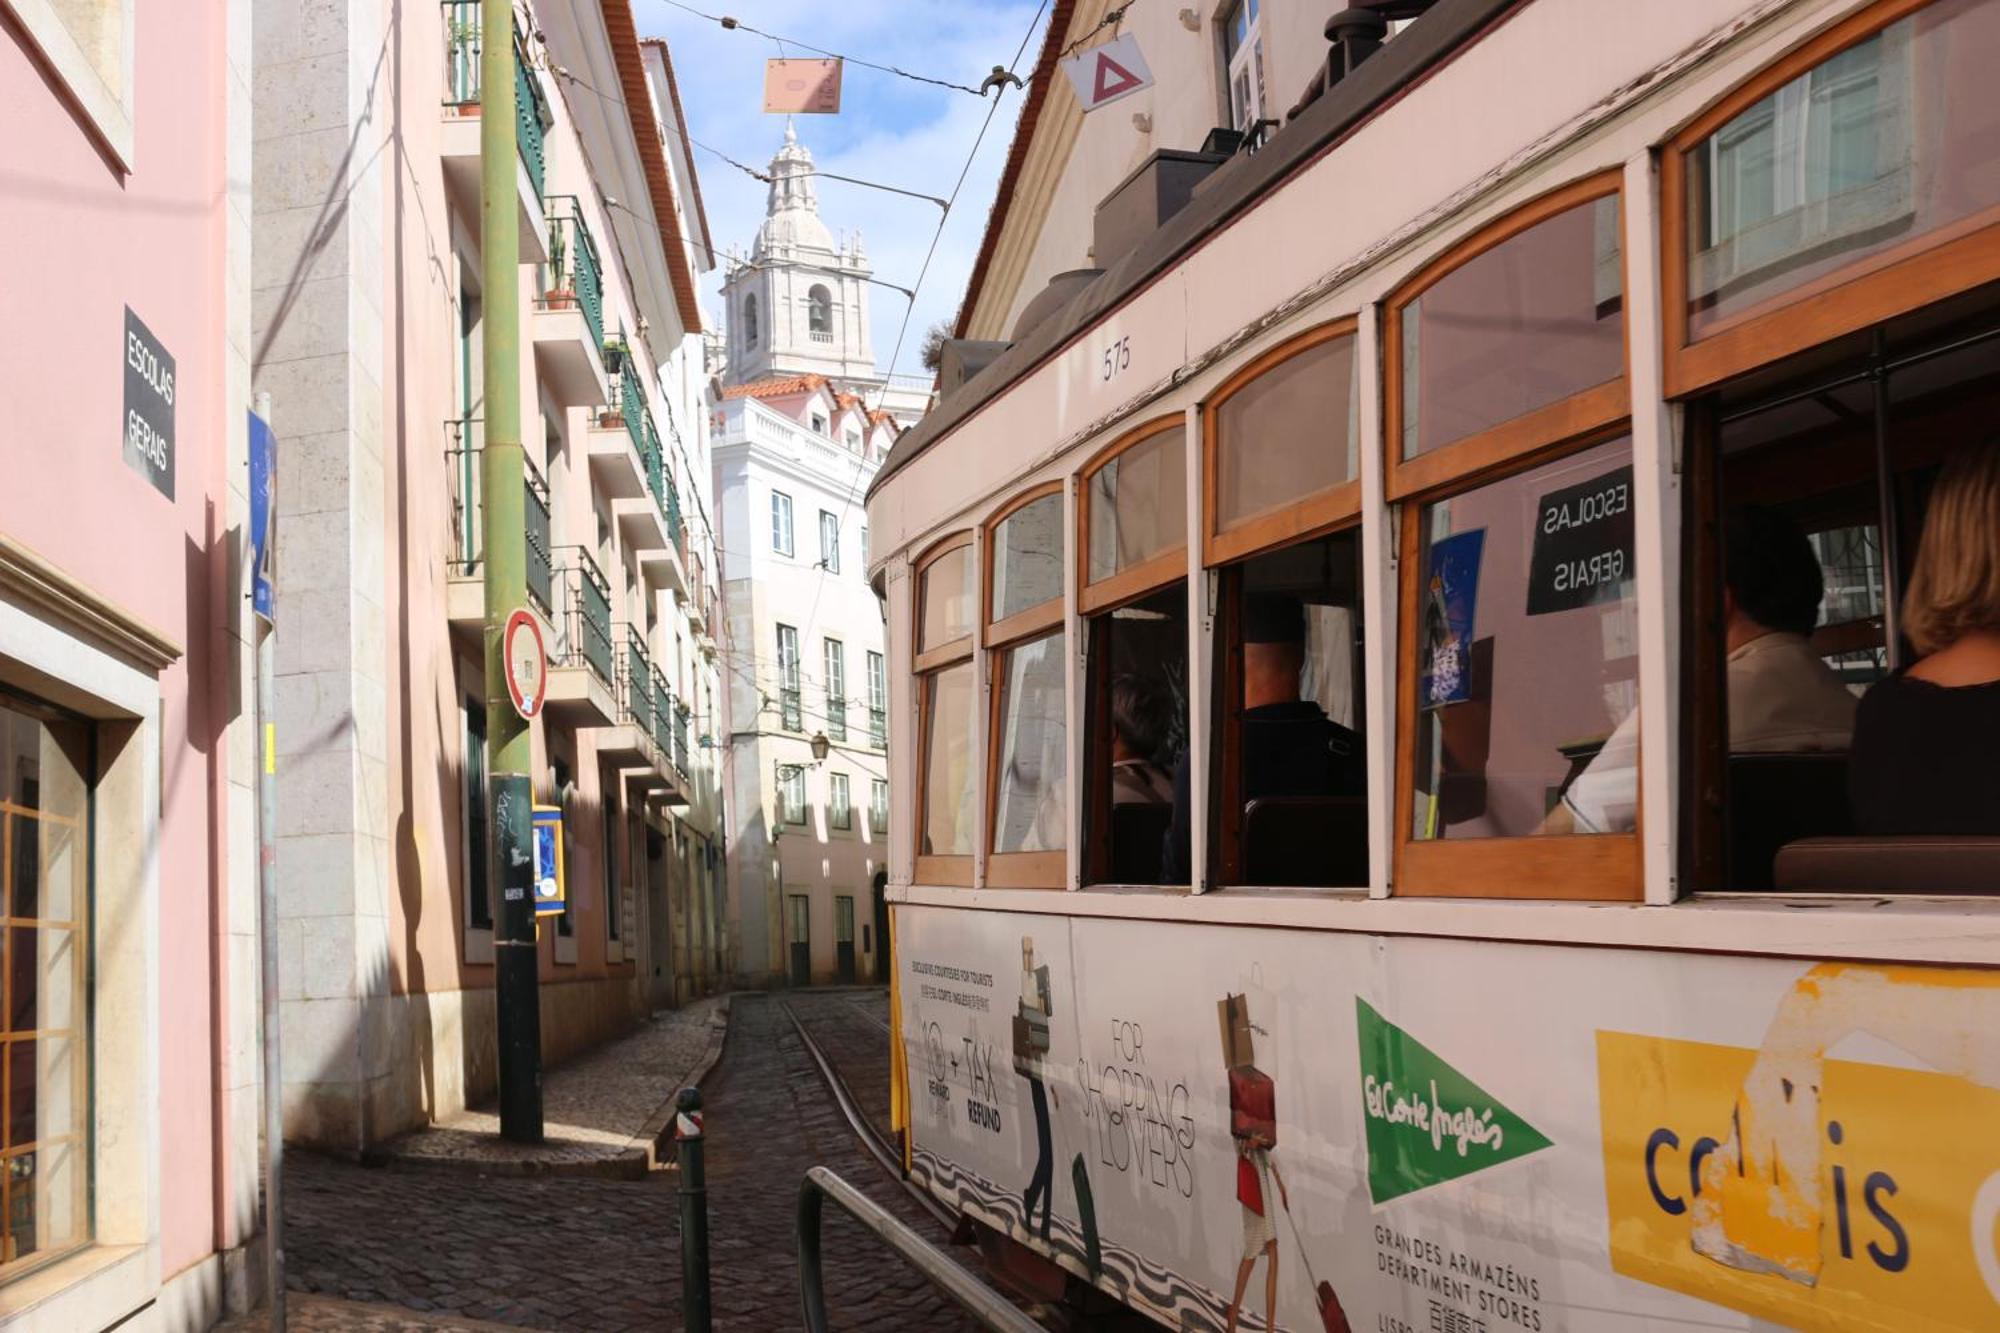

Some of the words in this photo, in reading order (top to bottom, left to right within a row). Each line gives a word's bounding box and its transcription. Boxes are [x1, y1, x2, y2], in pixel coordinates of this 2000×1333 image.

[128, 331, 173, 406] ESCOLAS
[1104, 336, 1130, 381] 575
[128, 409, 167, 471] GERAIS
[962, 1037, 998, 1105] TAX
[1112, 1019, 1145, 1064] FOR
[967, 1098, 1001, 1134] REFUND
[1078, 1057, 1195, 1149] SHOPPING
[1365, 1074, 1384, 1119] El
[1383, 1081, 1430, 1131] Corte
[1430, 1079, 1503, 1157] Inglés
[1096, 1106, 1193, 1198] LOVERS
[1374, 1224, 1443, 1267] GRANDES
[1450, 1251, 1540, 1302] ARMAZÉNS
[1378, 1251, 1471, 1304] DEPARTMENT
[1478, 1289, 1542, 1332] STORES
